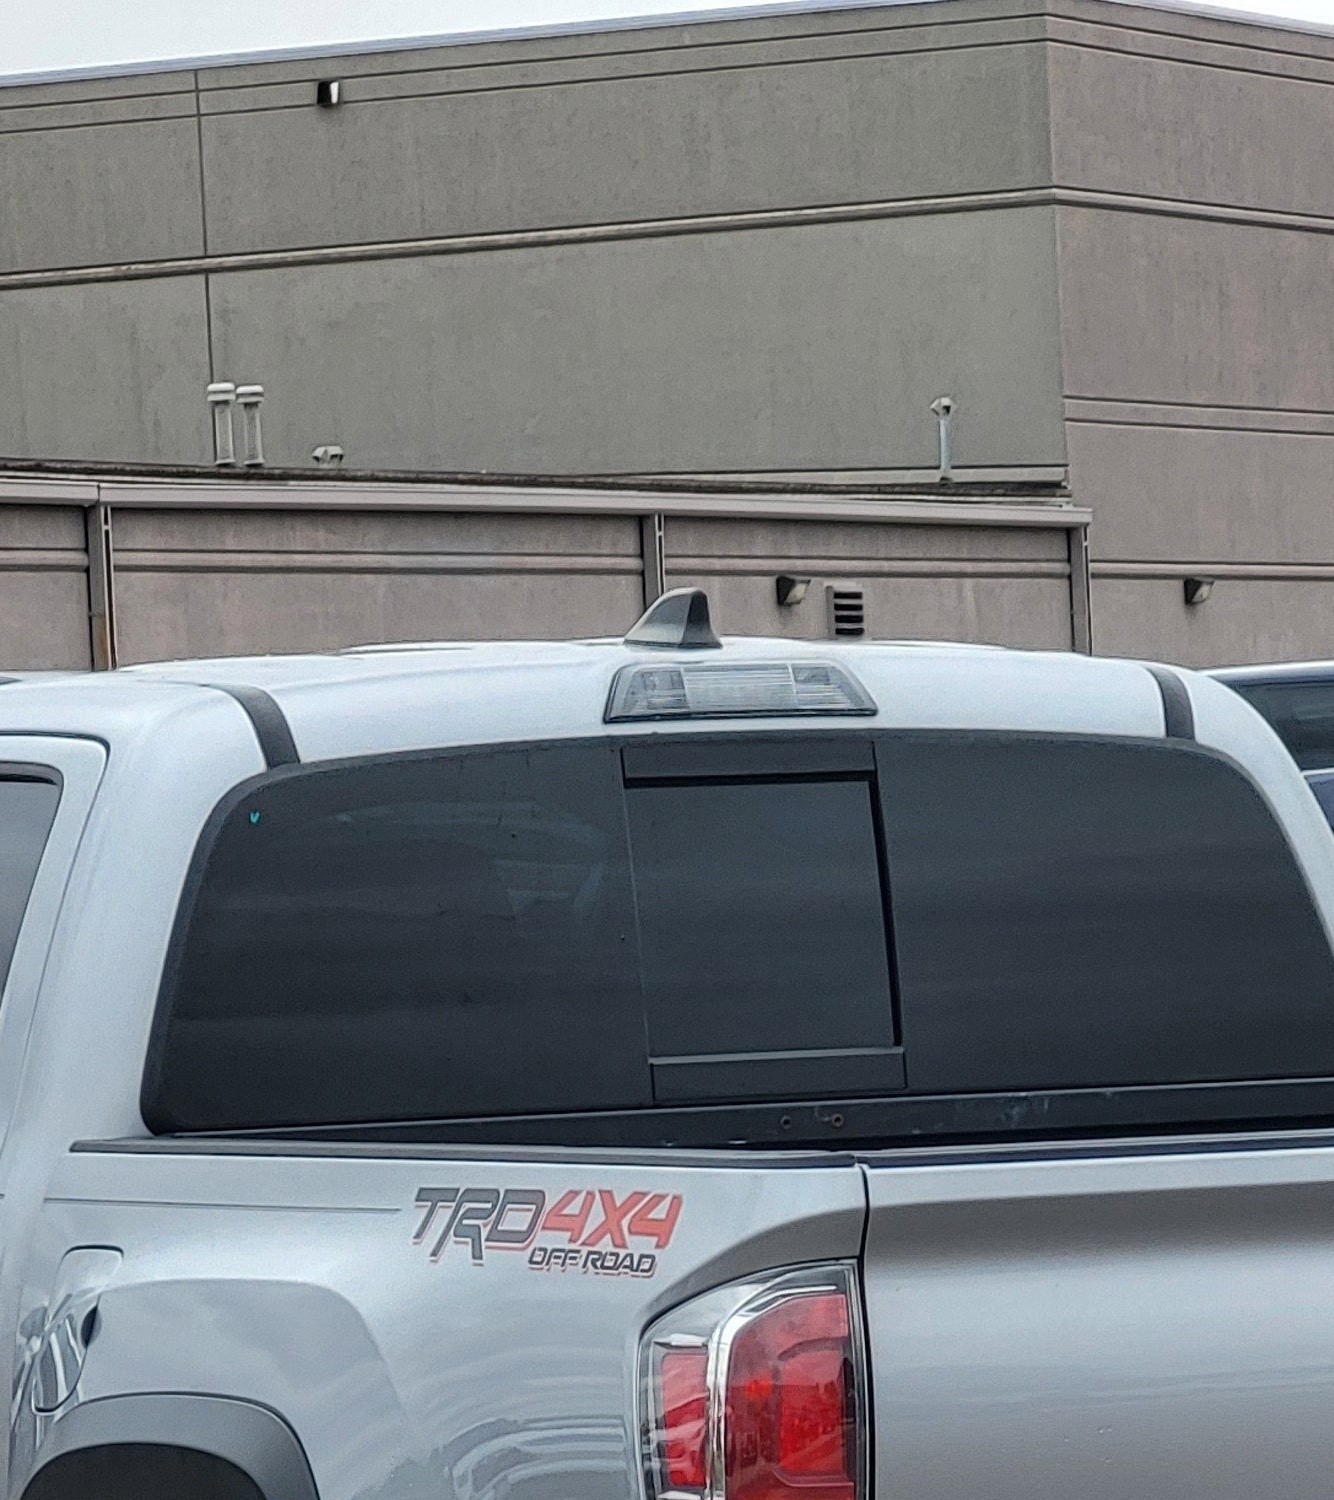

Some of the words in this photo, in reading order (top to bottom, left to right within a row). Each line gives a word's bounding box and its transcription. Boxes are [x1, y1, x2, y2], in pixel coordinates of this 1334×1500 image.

[413, 1186, 546, 1265] TRD
[540, 1189, 682, 1249] 4X4
[527, 1247, 582, 1272] OFF
[581, 1250, 657, 1278] ROAD
